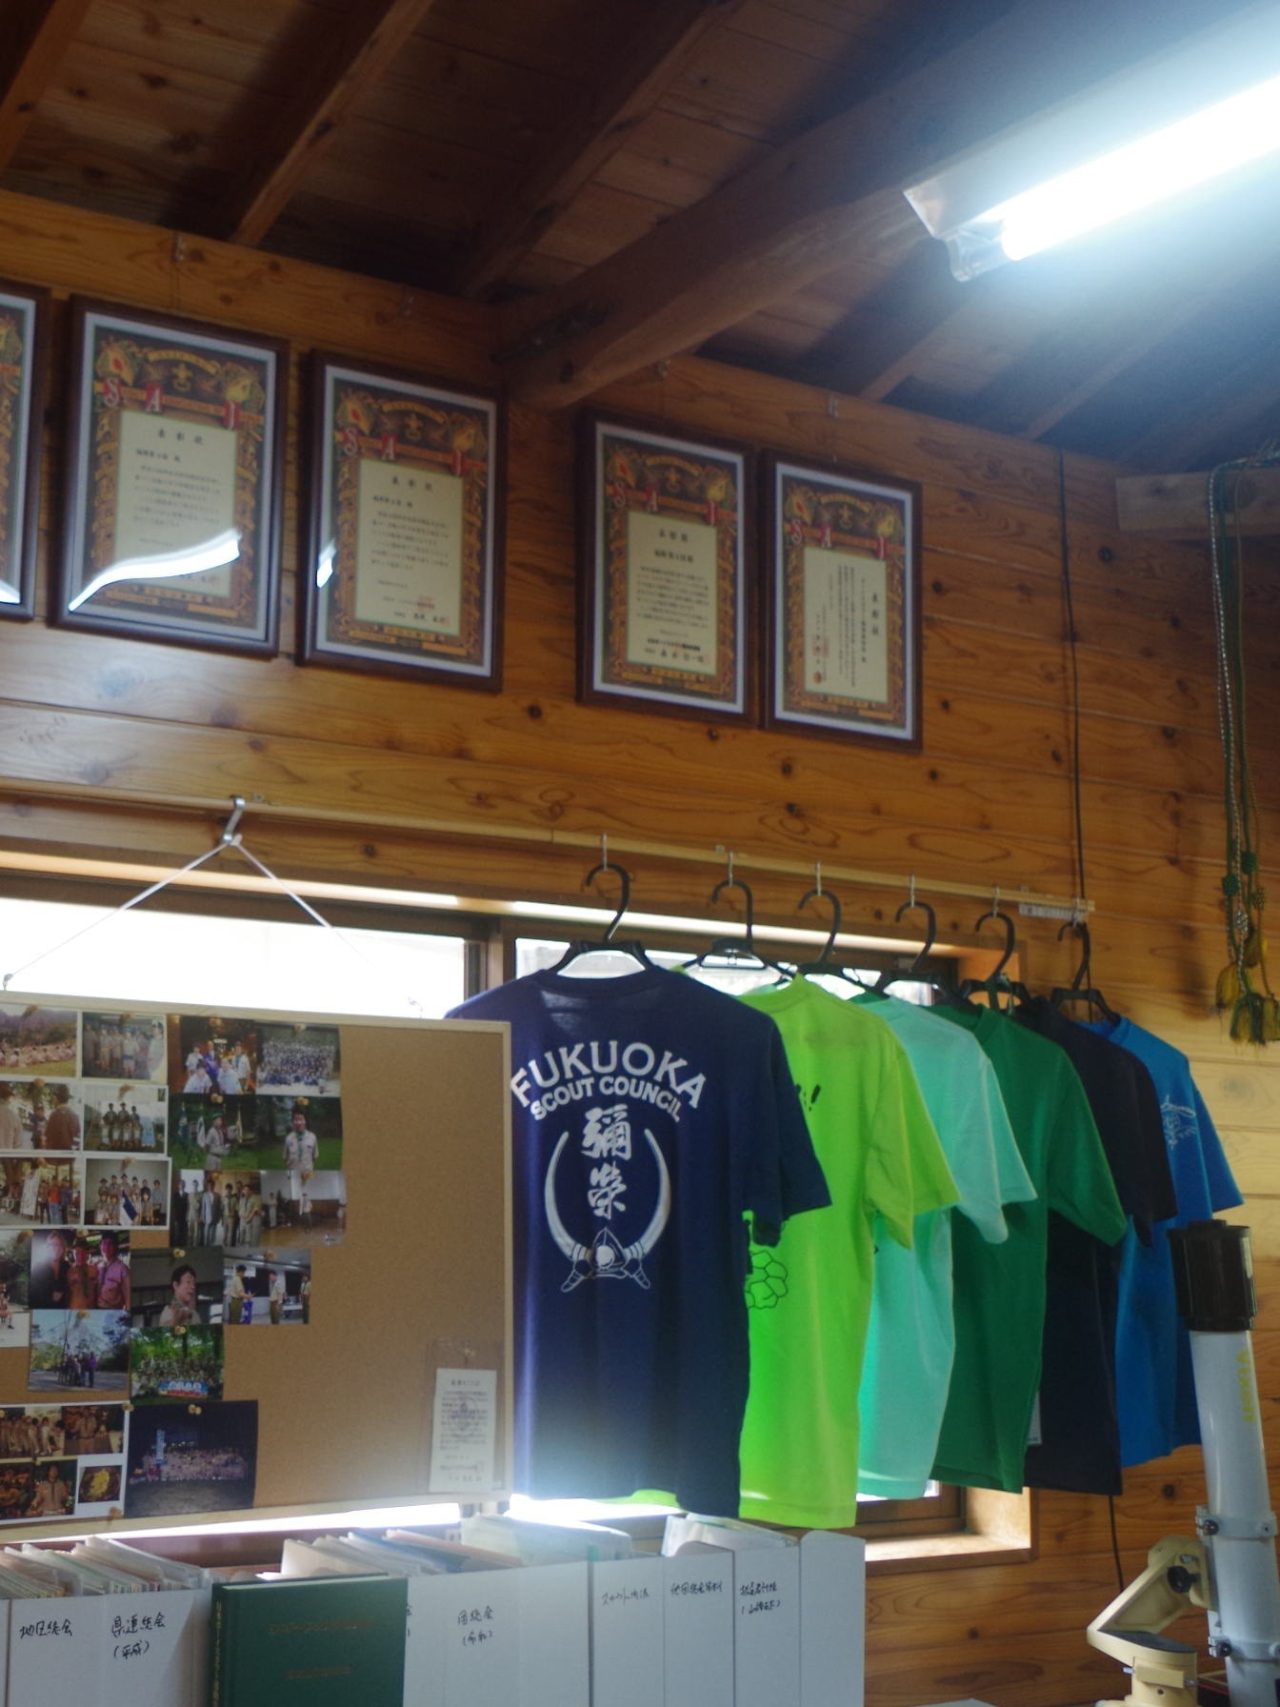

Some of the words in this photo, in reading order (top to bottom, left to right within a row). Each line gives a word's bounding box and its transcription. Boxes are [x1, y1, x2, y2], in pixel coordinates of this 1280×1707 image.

[146, 390, 161, 412] A
[382, 438, 397, 460] A
[647, 490, 658, 511] A
[822, 527, 832, 549] A
[510, 1040, 707, 1109] FUKUOKA
[530, 1076, 595, 1121] SCOUT
[599, 1075, 681, 1123] COUNCIL
